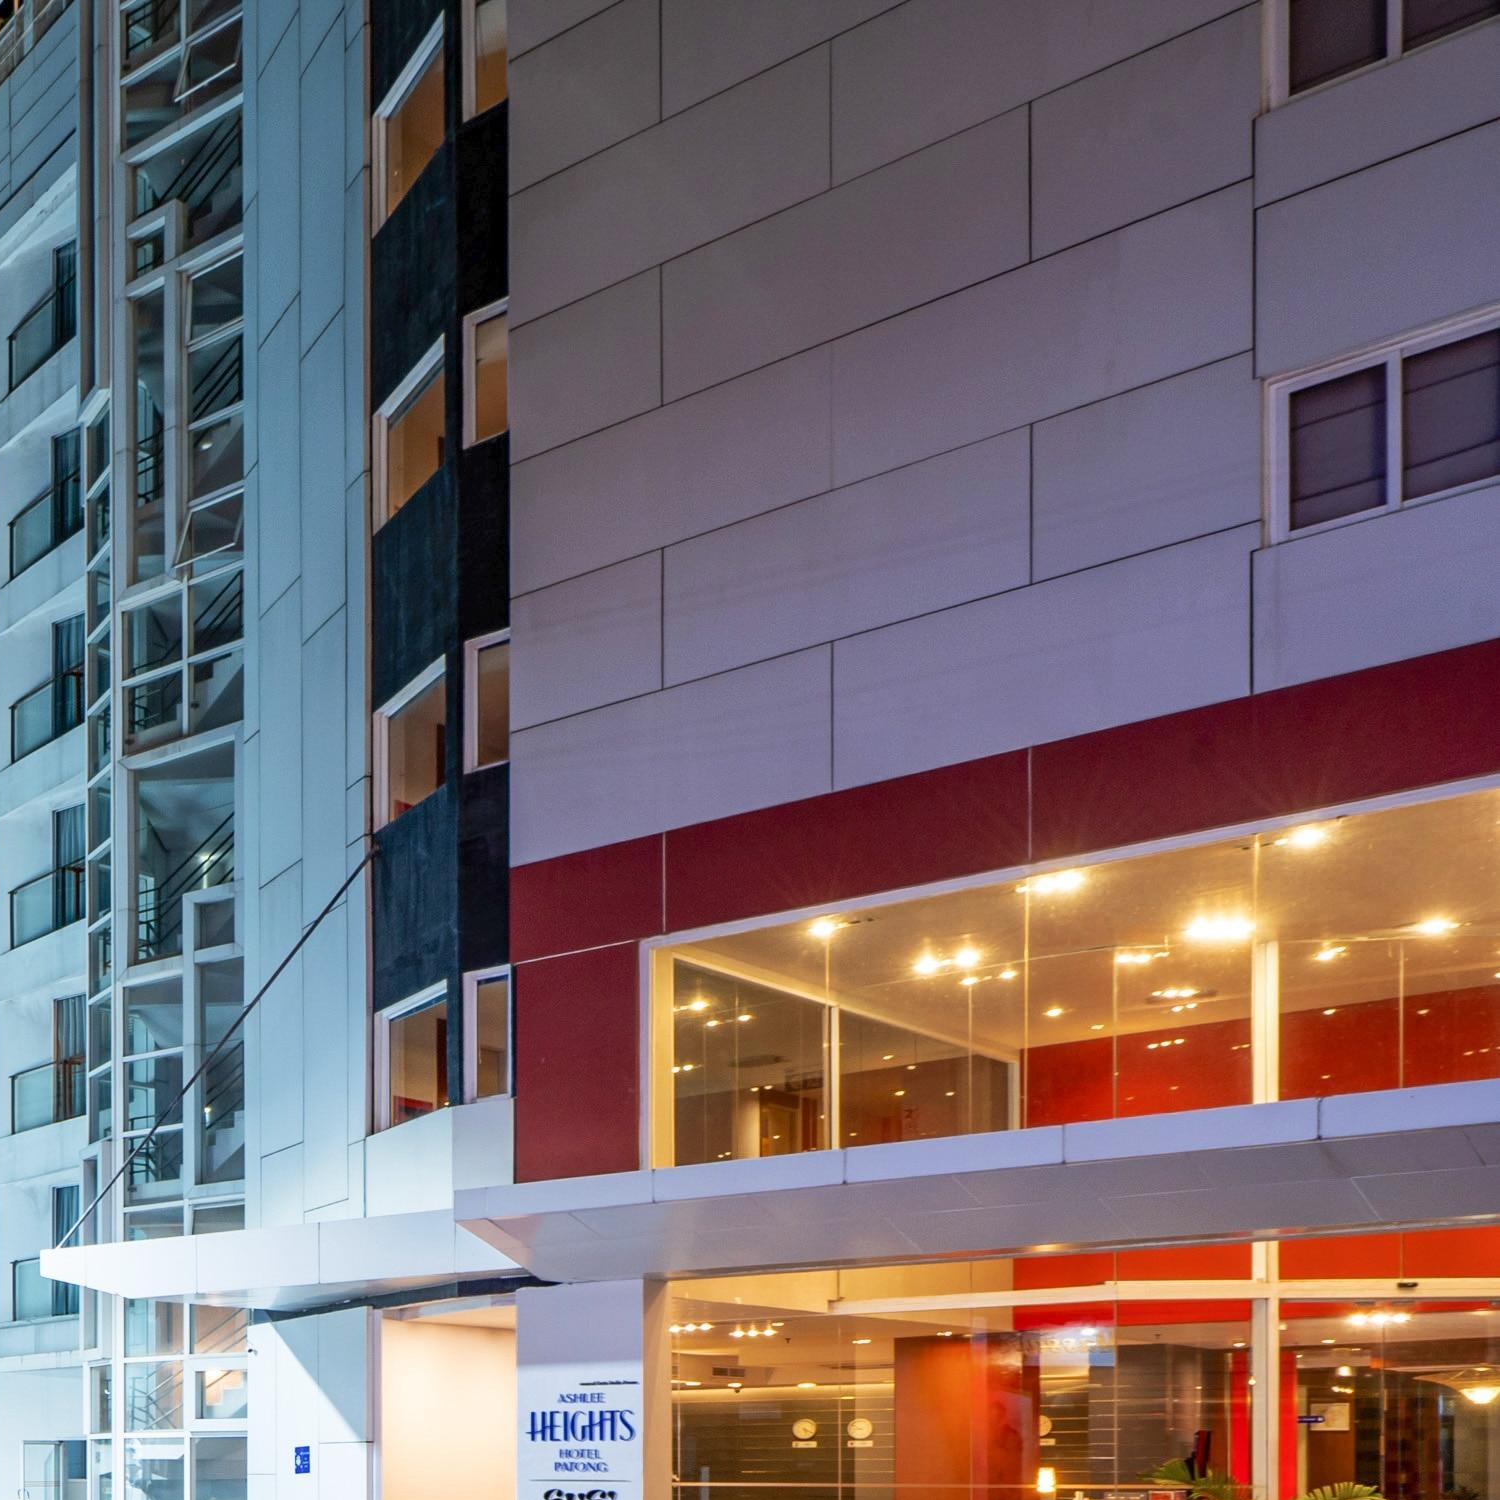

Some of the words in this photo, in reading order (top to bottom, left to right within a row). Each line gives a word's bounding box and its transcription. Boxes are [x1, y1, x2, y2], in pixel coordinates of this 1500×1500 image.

[556, 1392, 606, 1403] ASHLEE
[525, 1409, 636, 1442] HEIGHTS
[558, 1448, 602, 1460] HOTEL
[554, 1461, 608, 1473] PATONG
